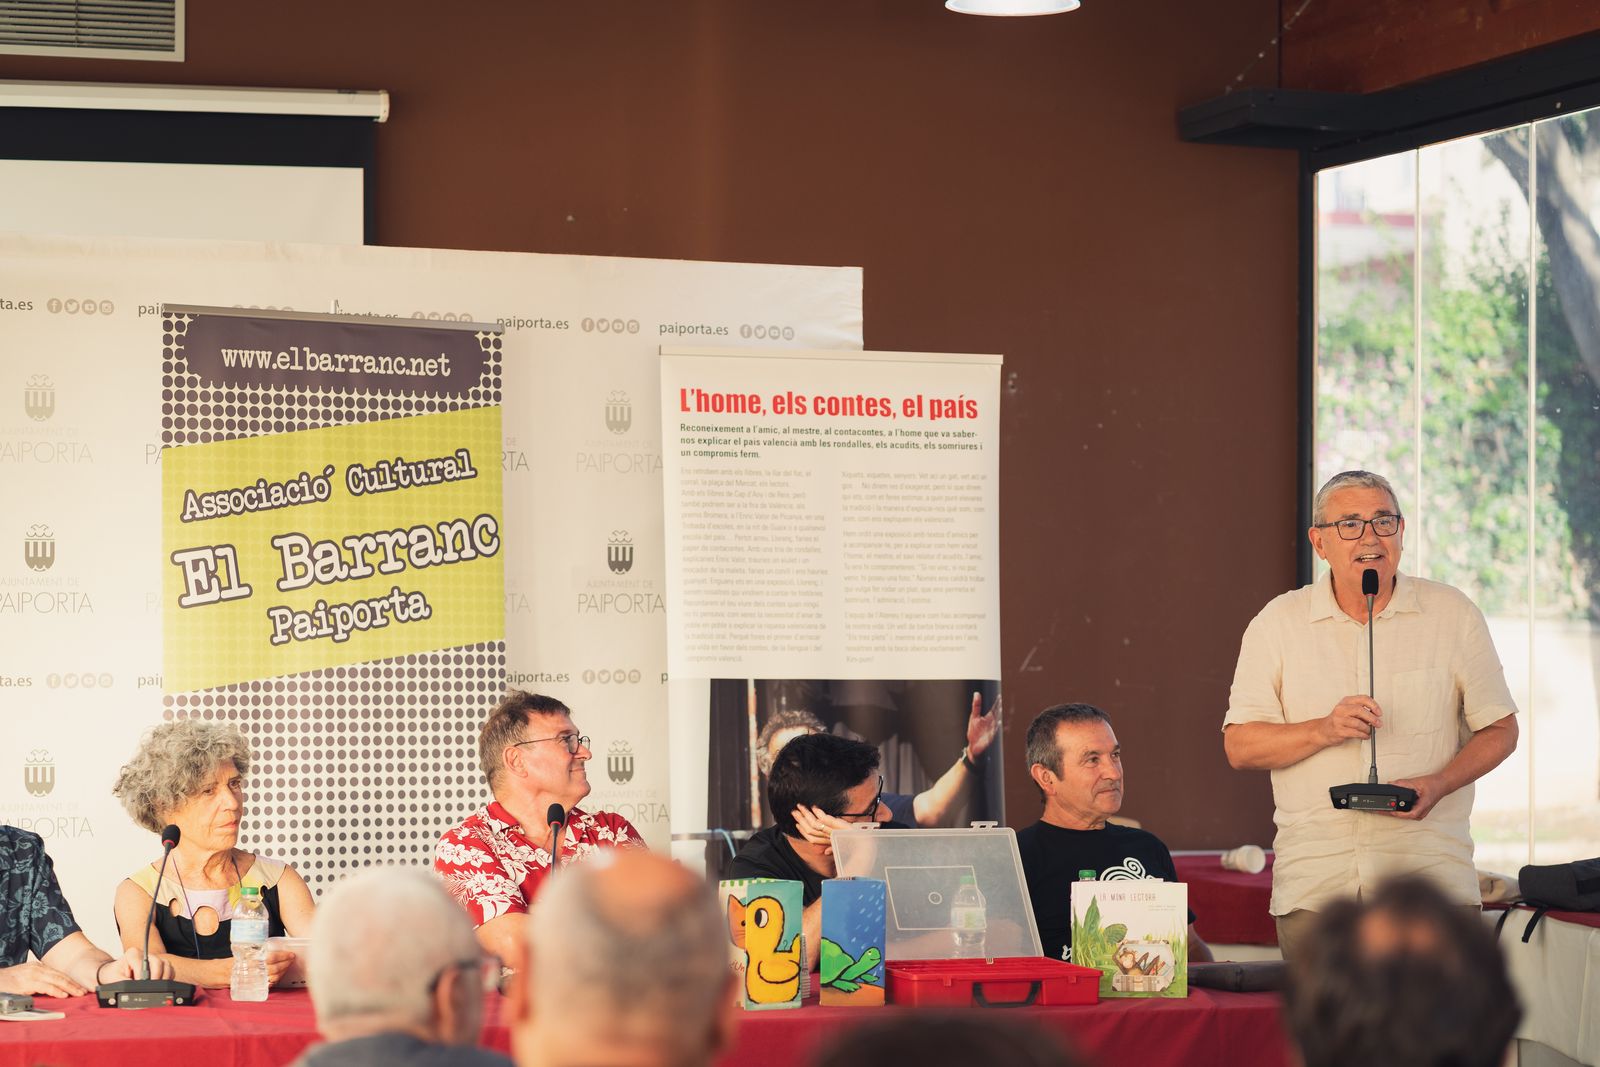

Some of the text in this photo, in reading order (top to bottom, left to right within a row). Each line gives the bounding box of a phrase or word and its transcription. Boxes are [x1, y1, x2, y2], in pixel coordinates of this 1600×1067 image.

[659, 323, 729, 336] paiporta.es
[221, 346, 451, 378] www.elbarranc.net
[680, 388, 978, 421] L'home, els contes, el país
[680, 423, 744, 433] Reconeixement
[753, 425, 780, 435] l'amic,
[782, 426, 790, 434] al
[792, 427, 822, 436] mestre,
[824, 427, 831, 435] al
[834, 428, 886, 437] contacontes,
[895, 428, 922, 437] l'home
[924, 430, 938, 439] que
[952, 430, 978, 439] saber-
[680, 437, 695, 445] nos
[697, 437, 731, 446] explicar
[733, 437, 741, 445] el
[800, 438, 817, 447] amb
[819, 439, 831, 447] les
[833, 440, 874, 449] rondalles,
[876, 440, 888, 449] els
[890, 441, 922, 450] acudits,
[924, 442, 936, 450] els
[938, 442, 978, 451] somriures
[680, 449, 691, 457] un
[347, 449, 477, 496] Cultural
[576, 452, 663, 473] PAIPORTA
[181, 465, 335, 522] Associació
[171, 514, 500, 608] El Barranc
[577, 593, 666, 613] PAIPORTA
[267, 586, 431, 646] Paiporta
[505, 671, 570, 684] aiporta.es
